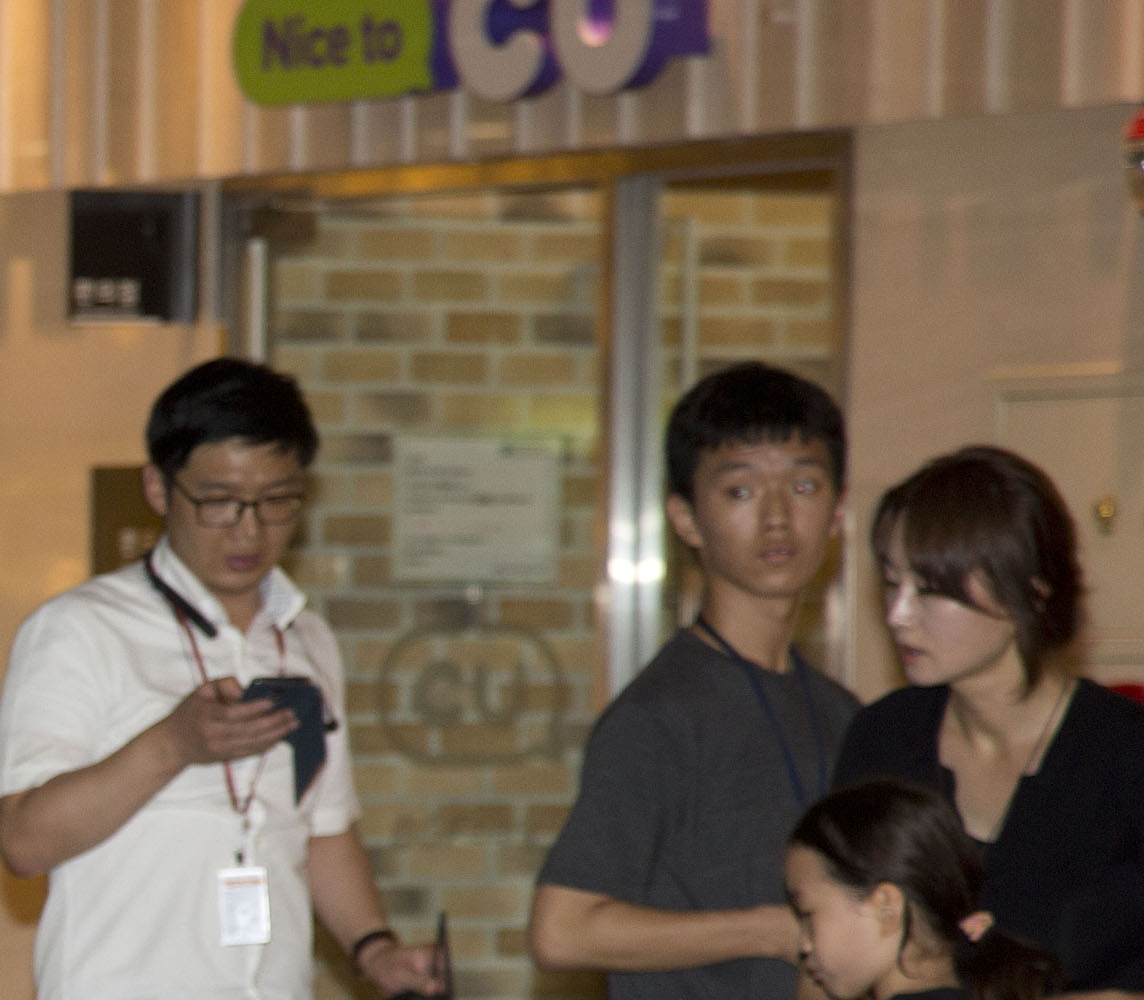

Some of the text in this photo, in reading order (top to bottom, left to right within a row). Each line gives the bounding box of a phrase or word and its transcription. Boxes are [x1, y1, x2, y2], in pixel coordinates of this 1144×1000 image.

[261, 0, 654, 101] Nice to CU
